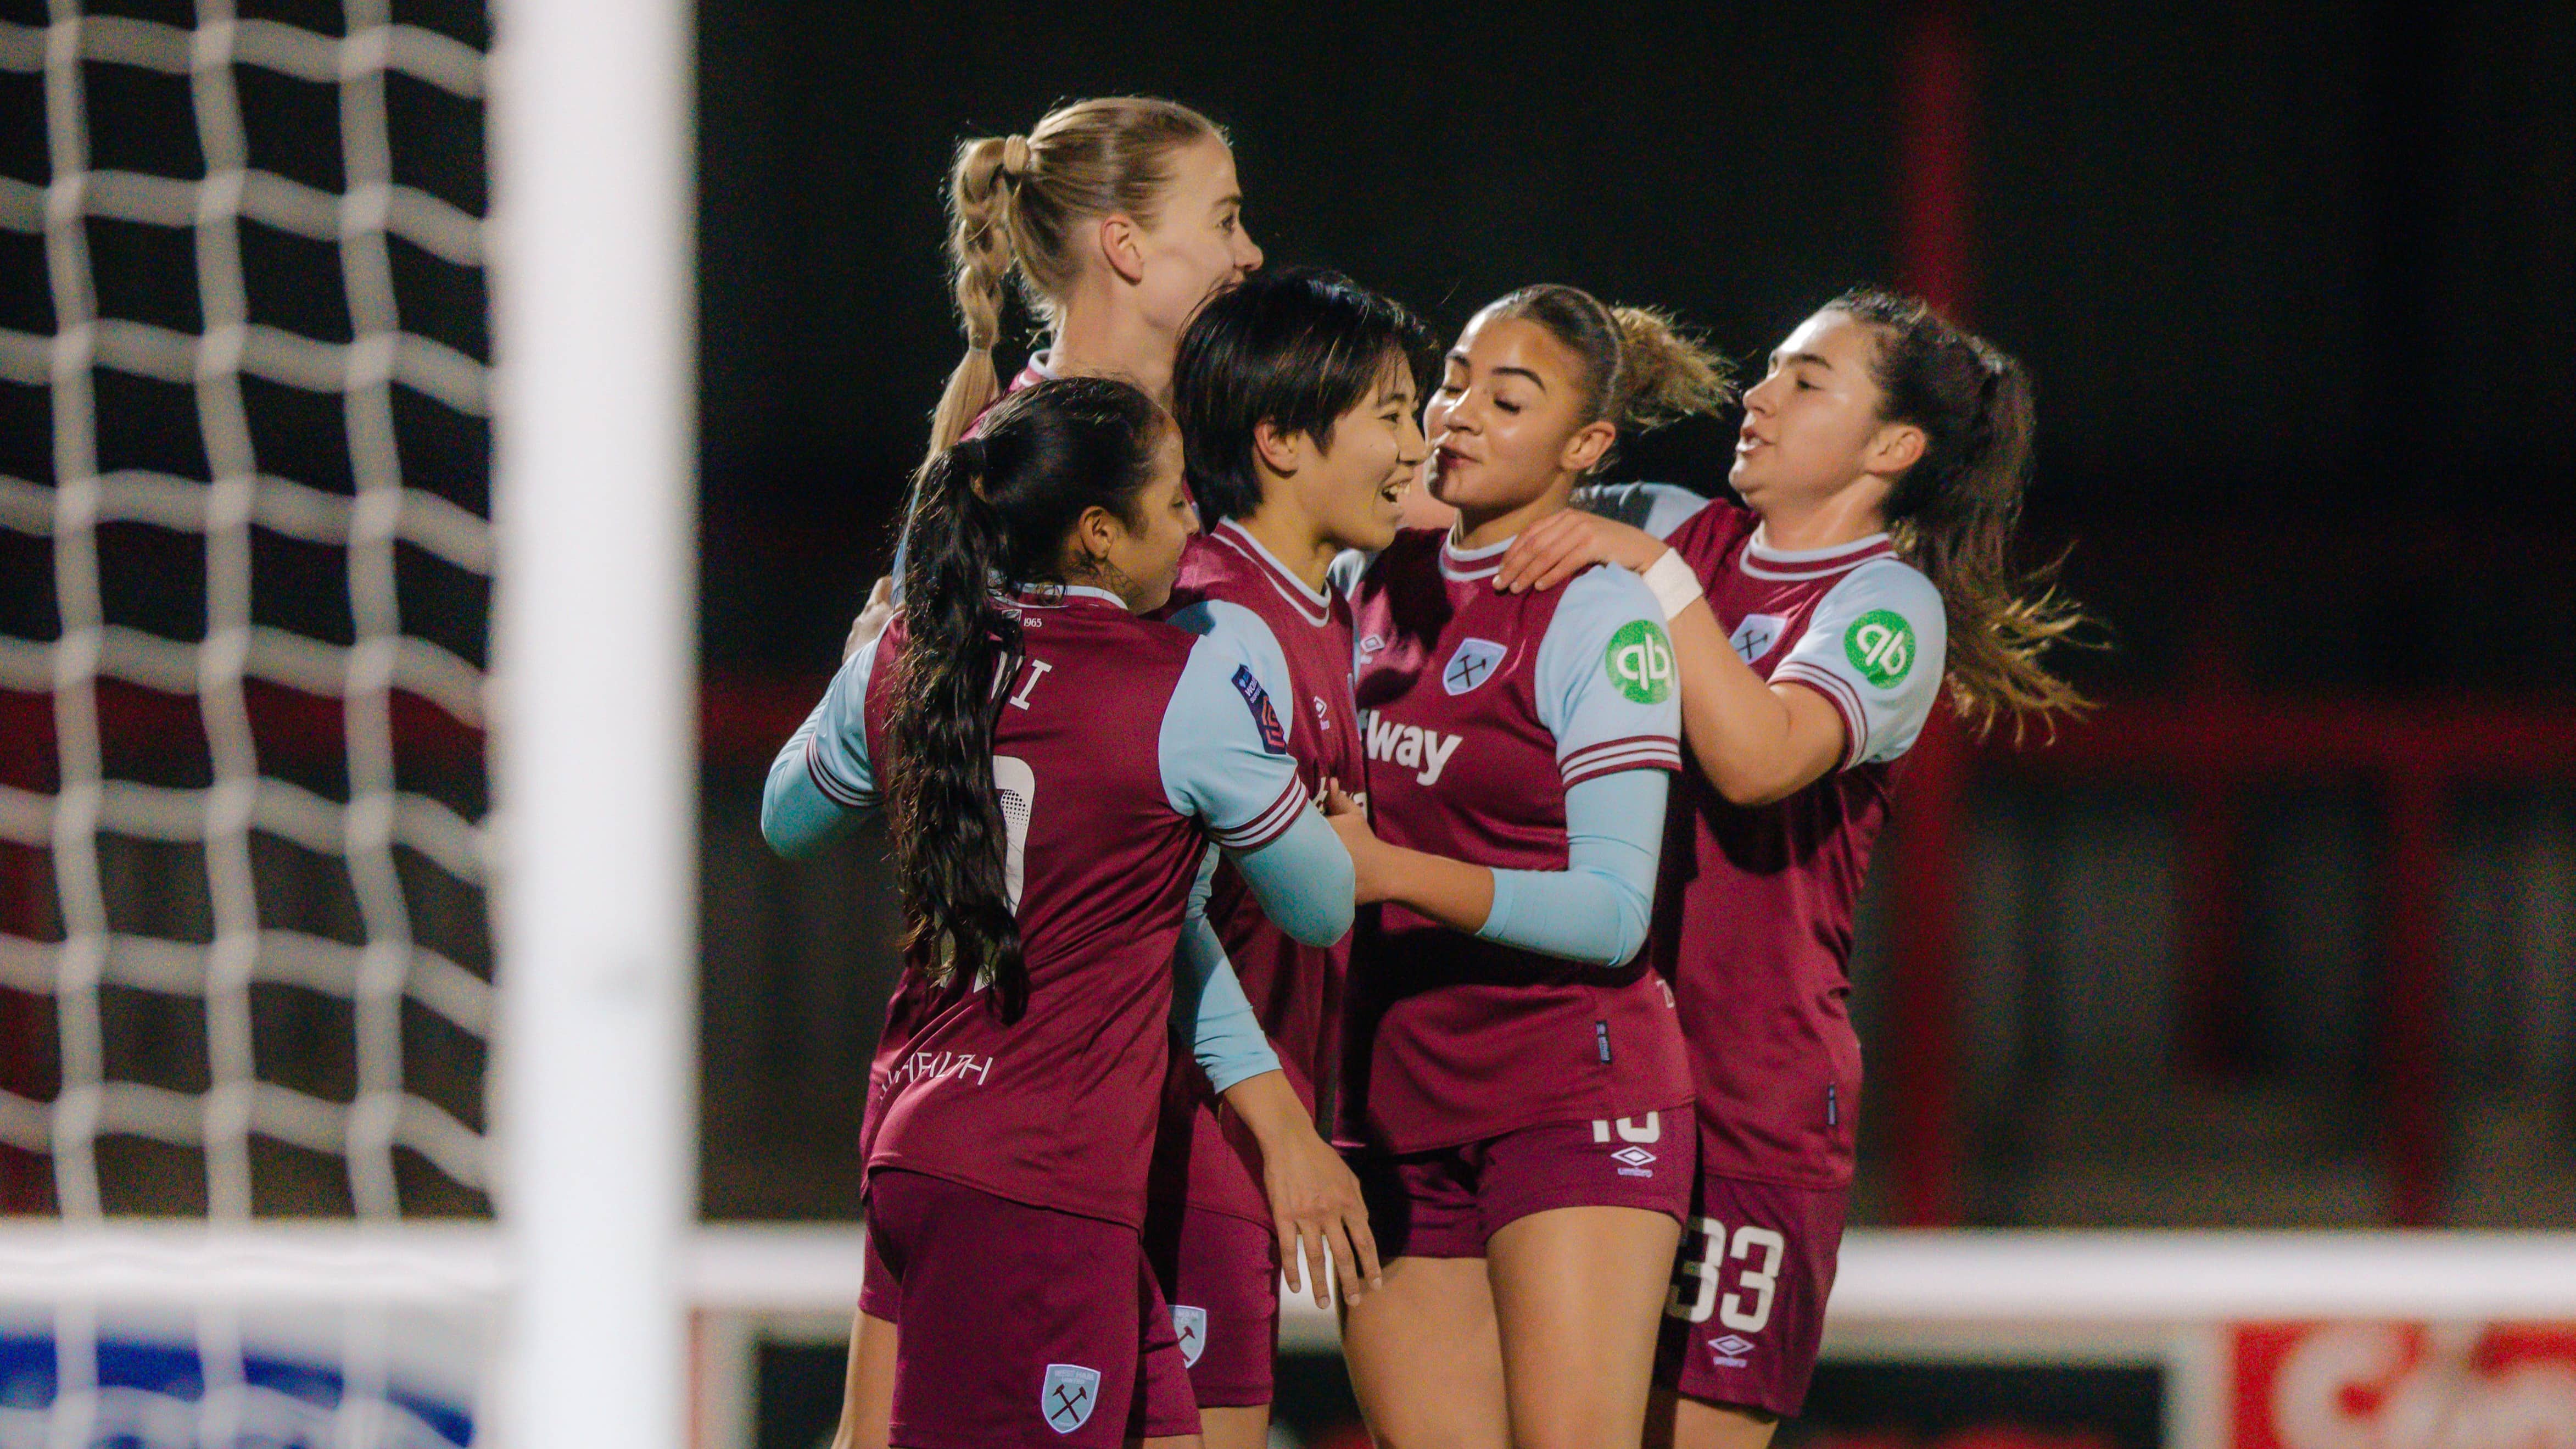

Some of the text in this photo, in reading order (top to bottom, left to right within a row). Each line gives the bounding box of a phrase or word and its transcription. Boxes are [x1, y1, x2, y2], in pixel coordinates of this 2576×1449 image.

[1023, 618, 1042, 627] 1965
[1857, 624, 1907, 675] qb
[1617, 633, 1672, 690] qb
[1357, 709, 1463, 786] way
[1666, 1217, 1784, 1333] 33
